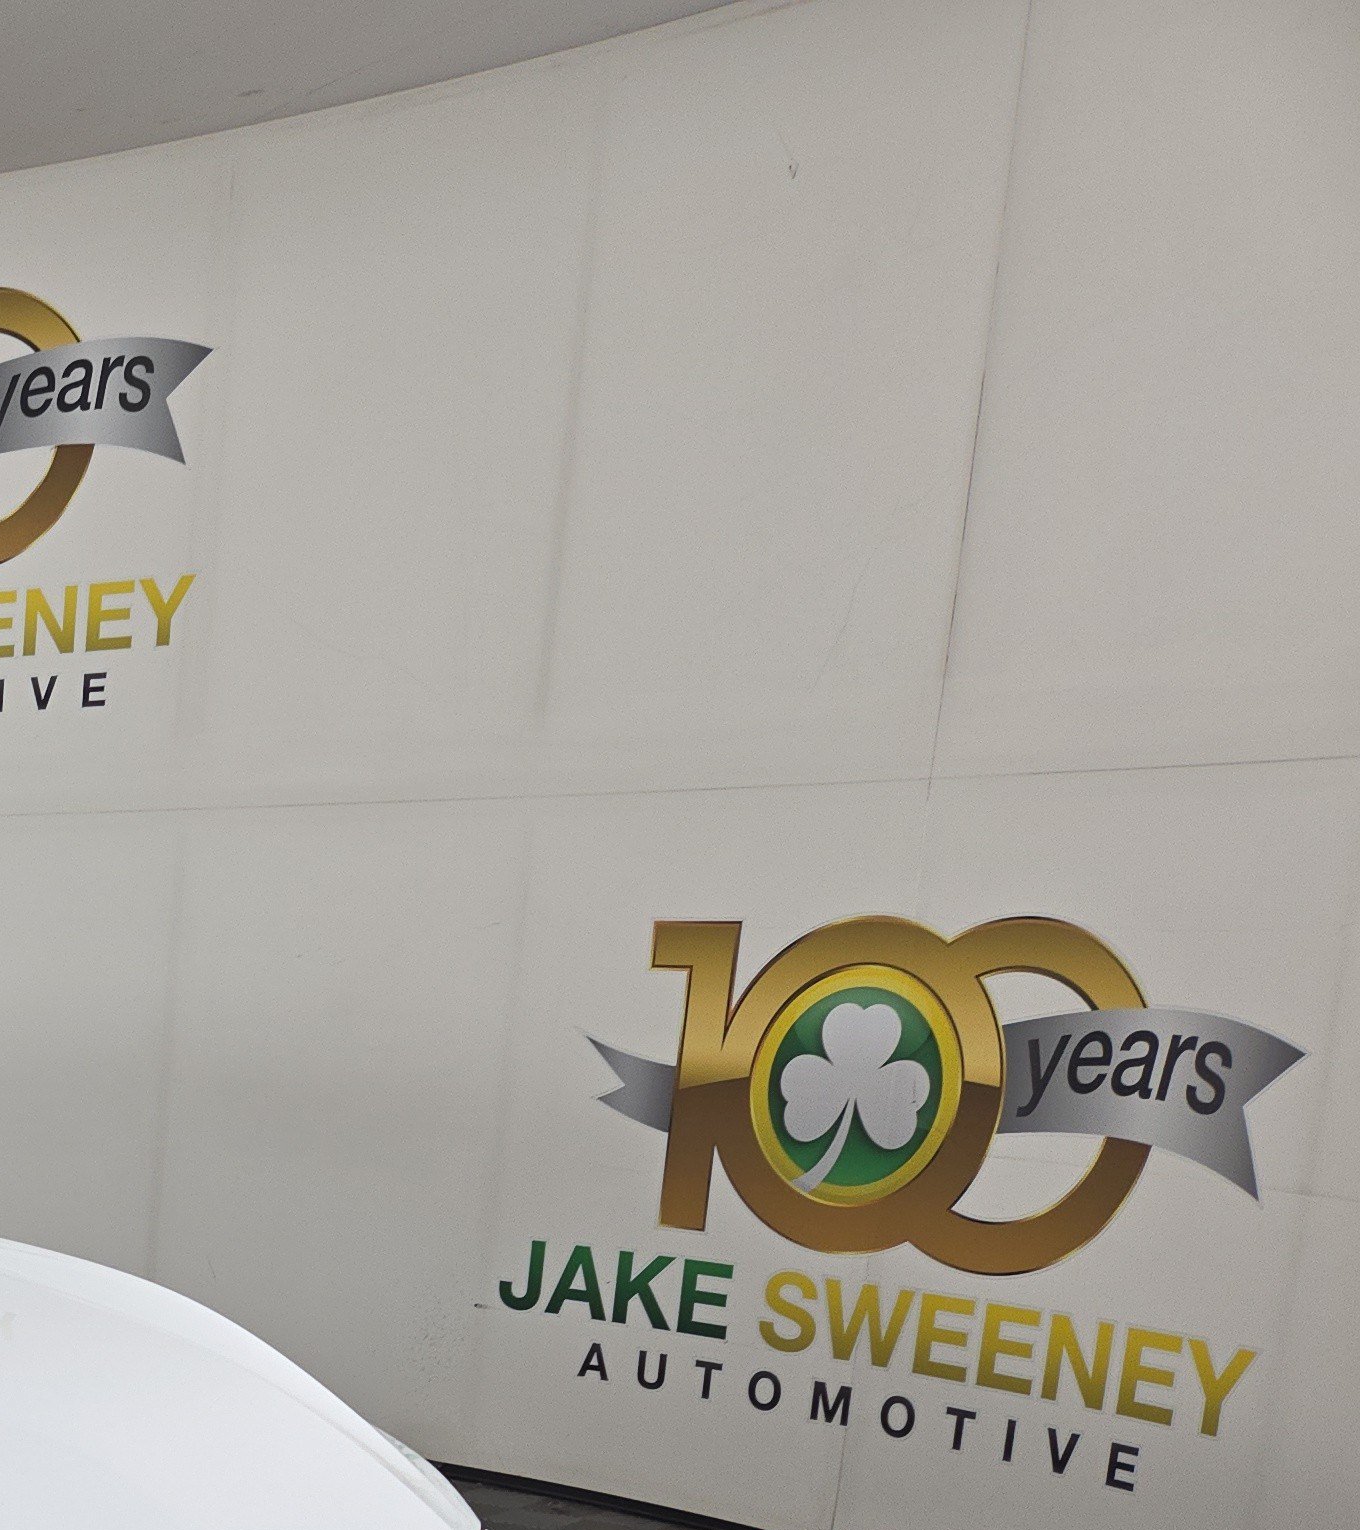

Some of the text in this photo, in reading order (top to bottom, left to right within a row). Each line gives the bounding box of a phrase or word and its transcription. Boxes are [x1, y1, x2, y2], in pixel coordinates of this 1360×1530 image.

[1016, 1026, 1233, 1118] years
[499, 1239, 1258, 1438] JAKE SWEENEY
[578, 1343, 1140, 1491] AUTOMOTIVE
